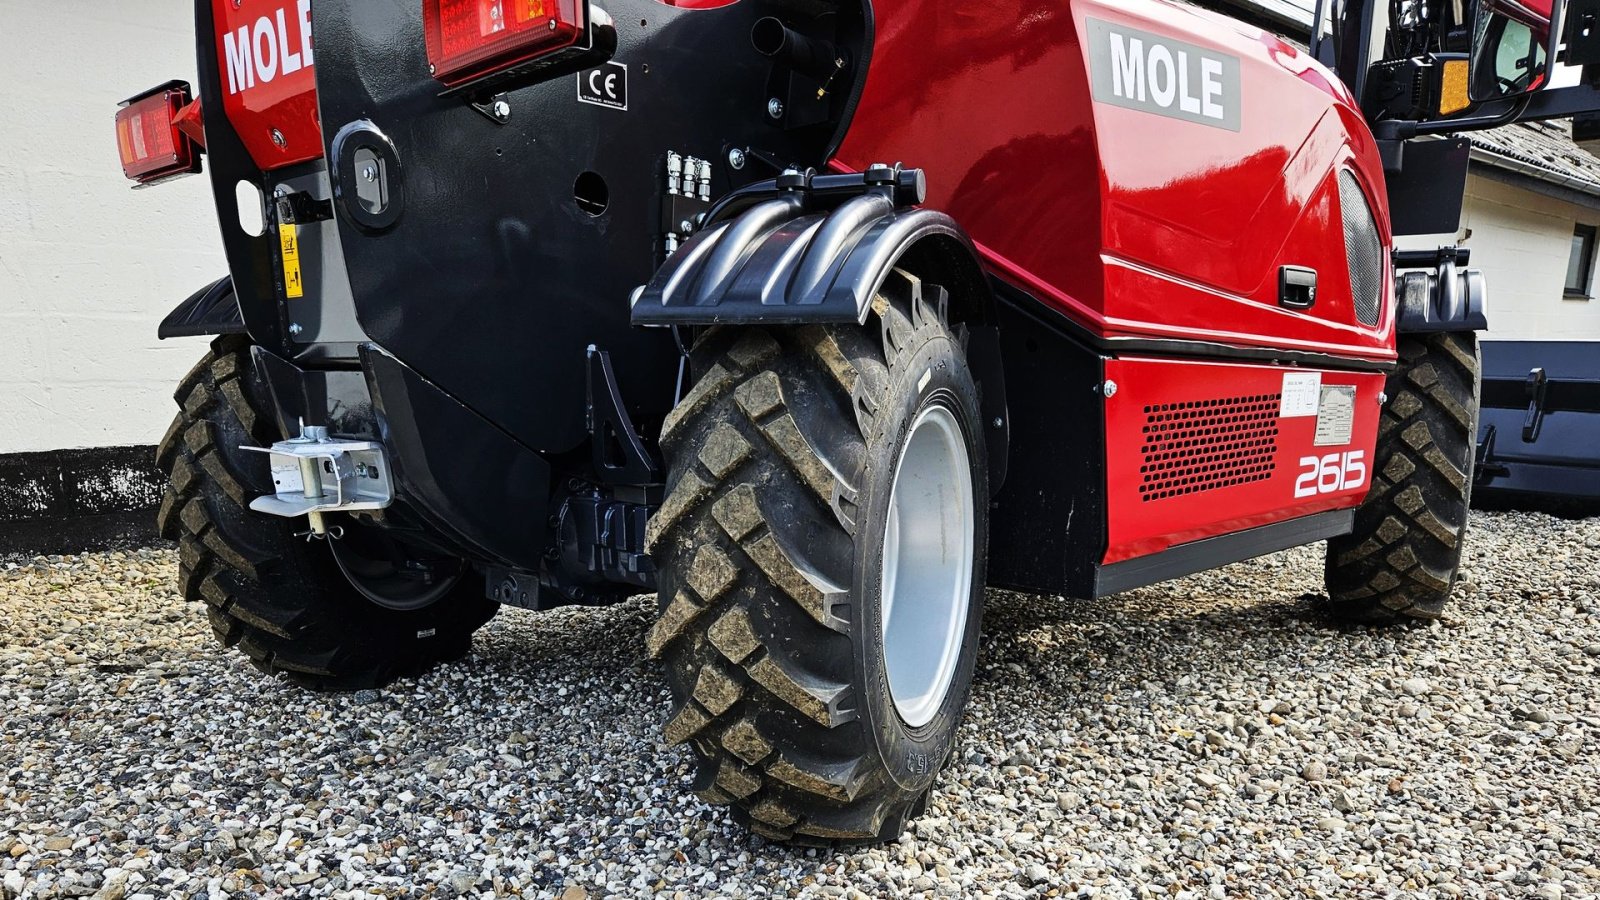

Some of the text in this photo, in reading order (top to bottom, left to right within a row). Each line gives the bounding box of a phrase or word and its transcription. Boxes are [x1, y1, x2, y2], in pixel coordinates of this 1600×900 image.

[223, 0, 315, 95] MOLE
[1109, 31, 1224, 120] MOLE
[1294, 449, 1366, 498] 2615
